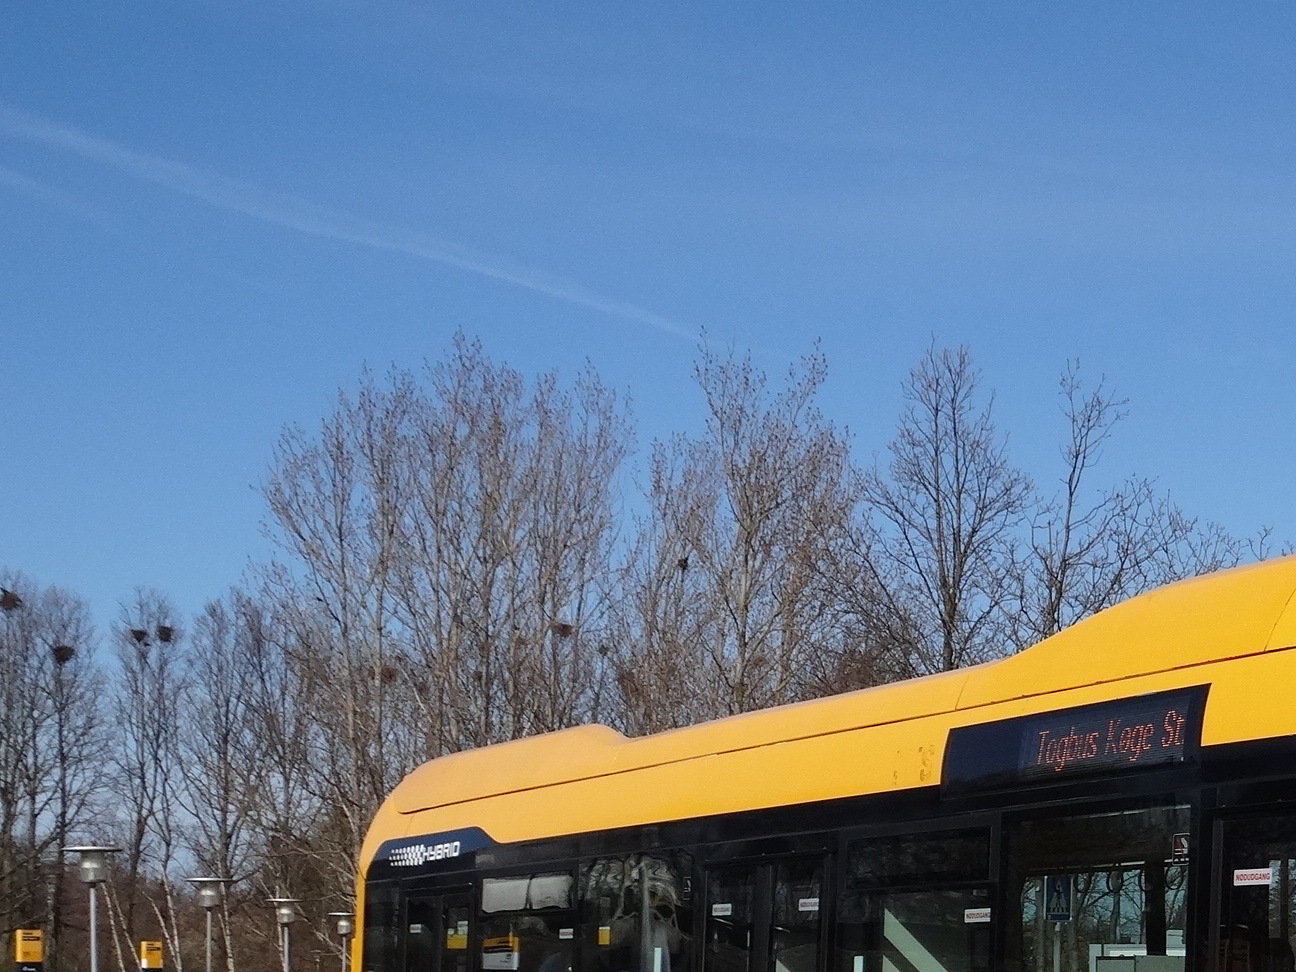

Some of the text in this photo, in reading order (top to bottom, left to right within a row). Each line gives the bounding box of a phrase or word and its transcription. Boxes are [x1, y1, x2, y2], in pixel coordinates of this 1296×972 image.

[1036, 726, 1100, 772] Togbus
[1104, 719, 1155, 761] Køge
[423, 841, 461, 862] HYBRID
